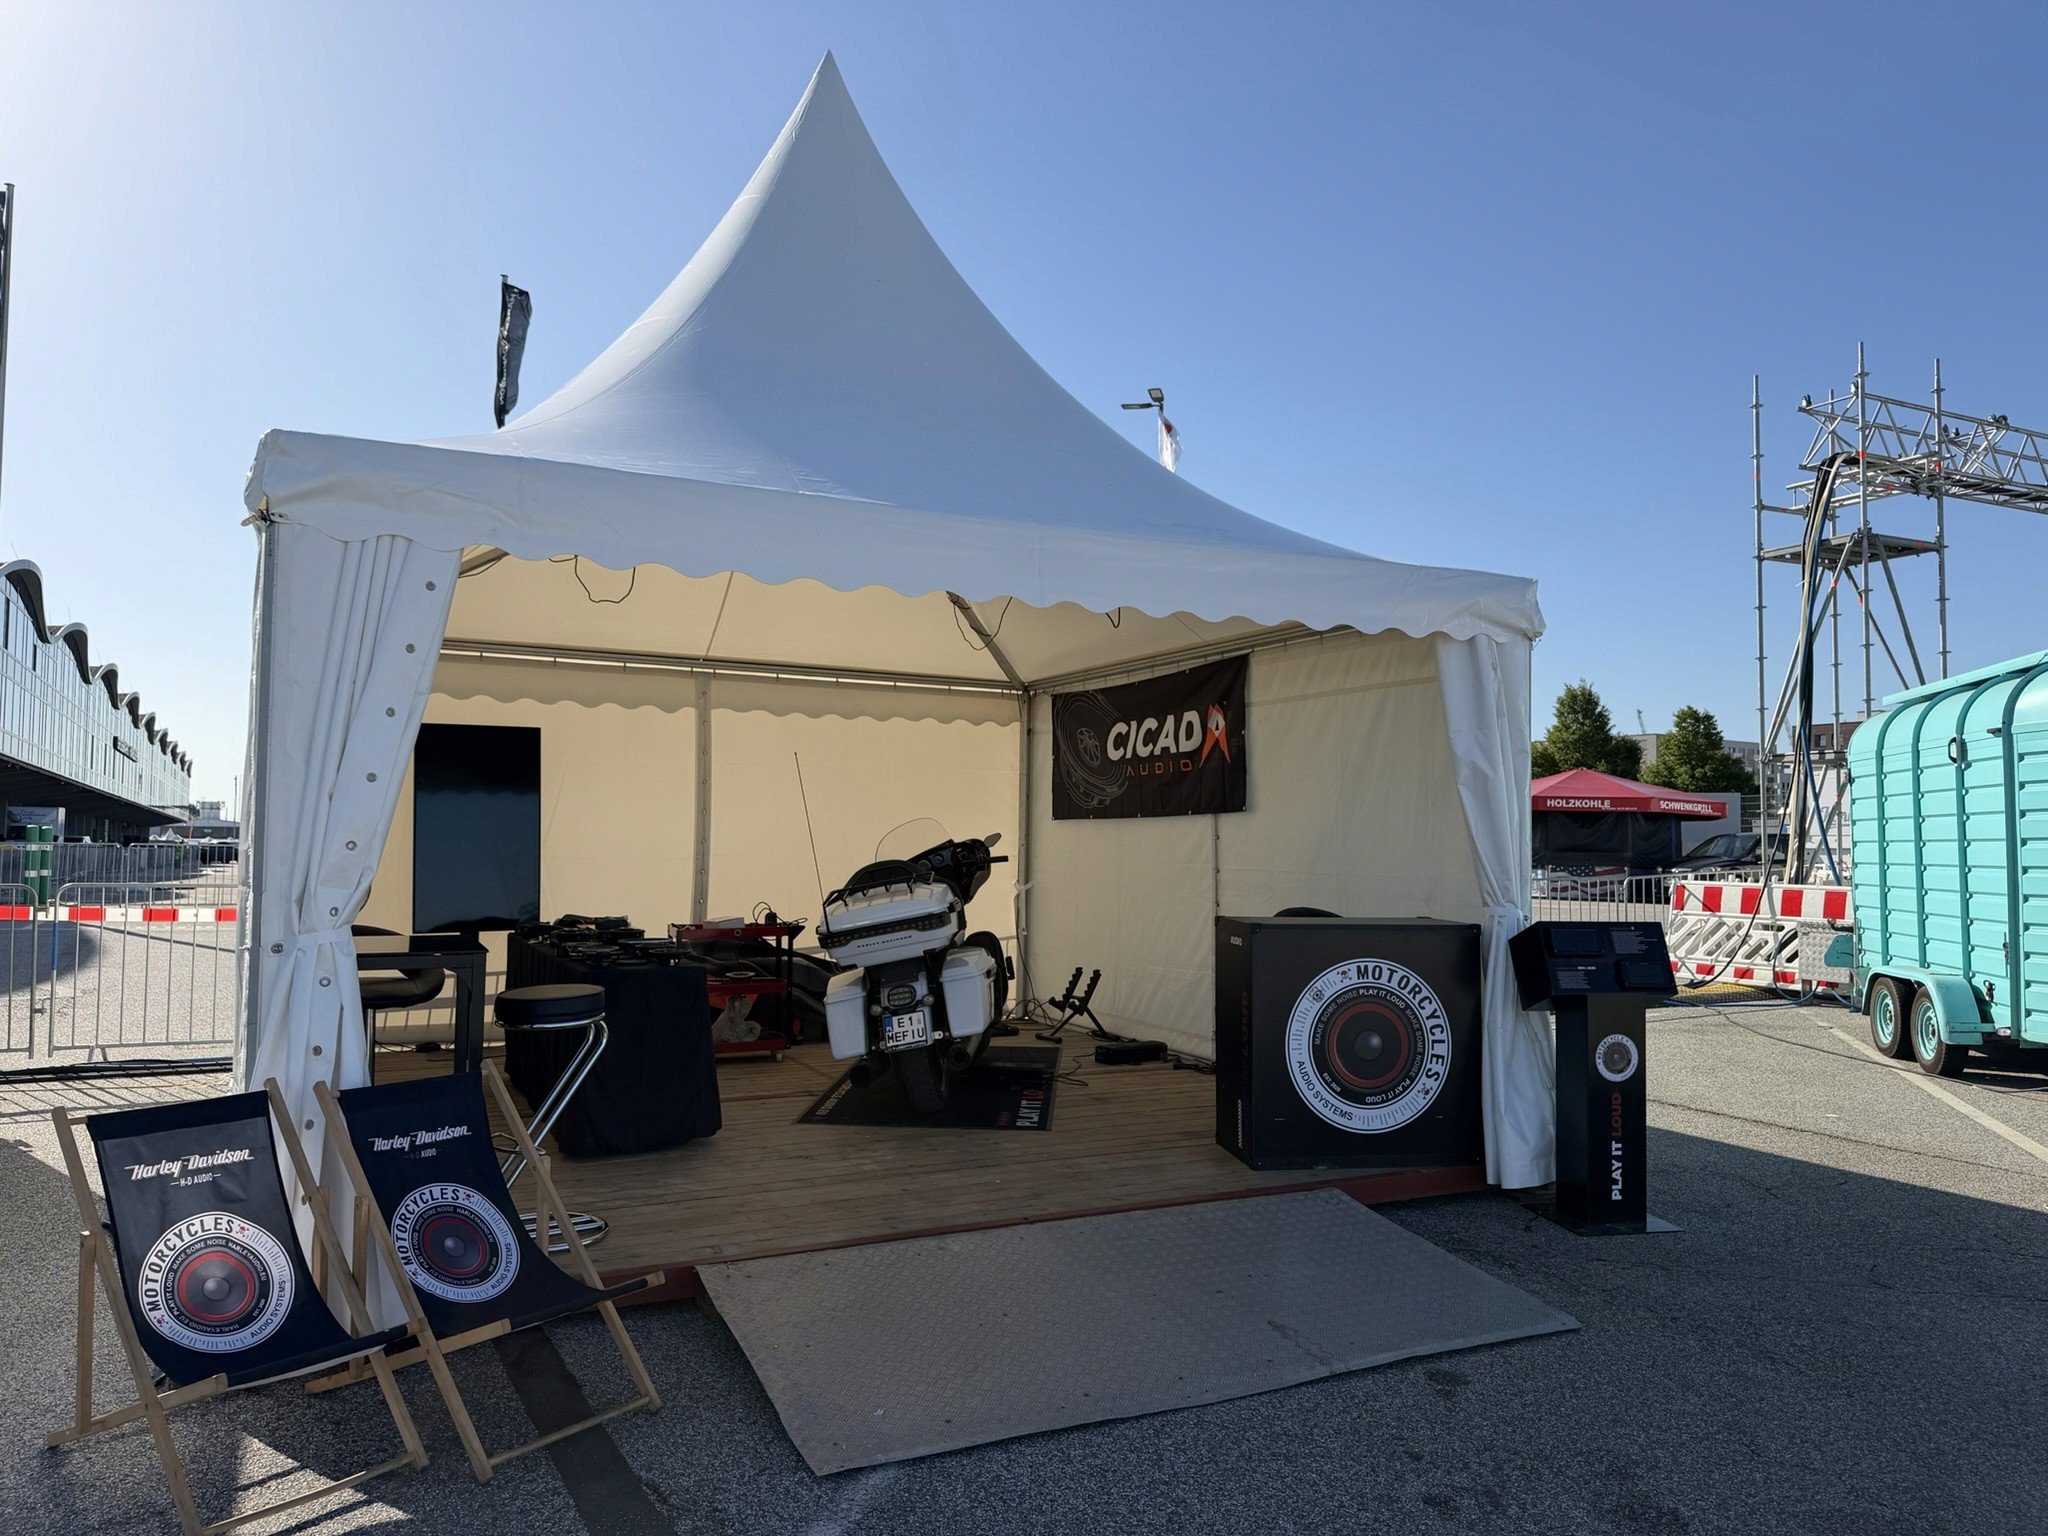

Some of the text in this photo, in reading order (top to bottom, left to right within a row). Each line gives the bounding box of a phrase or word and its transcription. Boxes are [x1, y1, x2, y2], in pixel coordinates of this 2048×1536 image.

[1107, 703, 1231, 768] CICADA
[1126, 759, 1193, 777] AUDIO
[1547, 798, 1611, 809] HOLZKOHLE
[1659, 800, 1714, 813] SCHWENKGRILL
[1337, 990, 1358, 1006] NOISE
[1359, 988, 1378, 996] PLAY
[1378, 989, 1387, 997] IT
[1386, 992, 1406, 1009] LOUD
[1321, 1003, 1338, 1022] SOME
[1406, 1009, 1419, 1031] MAKE
[1314, 1021, 1325, 1046] MAKE
[1356, 964, 1446, 1083] MOTORCYCLES
[1415, 1031, 1424, 1053] SOME
[1410, 1055, 1423, 1078] NOISE
[1296, 1060, 1354, 1121] AUDIO SYSTEMS
[367, 1125, 472, 1152] Harley-Davidson
[1611, 1092, 1623, 1201] PLAY IT LOUD
[421, 1148, 437, 1158] AUDIO
[124, 1148, 256, 1181] Harley-Davidson
[180, 1172, 213, 1187] H-D AUDIO
[396, 1187, 460, 1267] MOTORCYCLES
[187, 1242, 206, 1256] SOME
[207, 1238, 226, 1246] NOISE
[144, 1216, 235, 1313] MOTORCYCLES
[504, 1242, 513, 1273] SYSTEMS
[165, 1271, 174, 1291] LOUD
[167, 1299, 180, 1317] PLAY
[250, 1280, 287, 1339] AUDIO SYSTEMS
